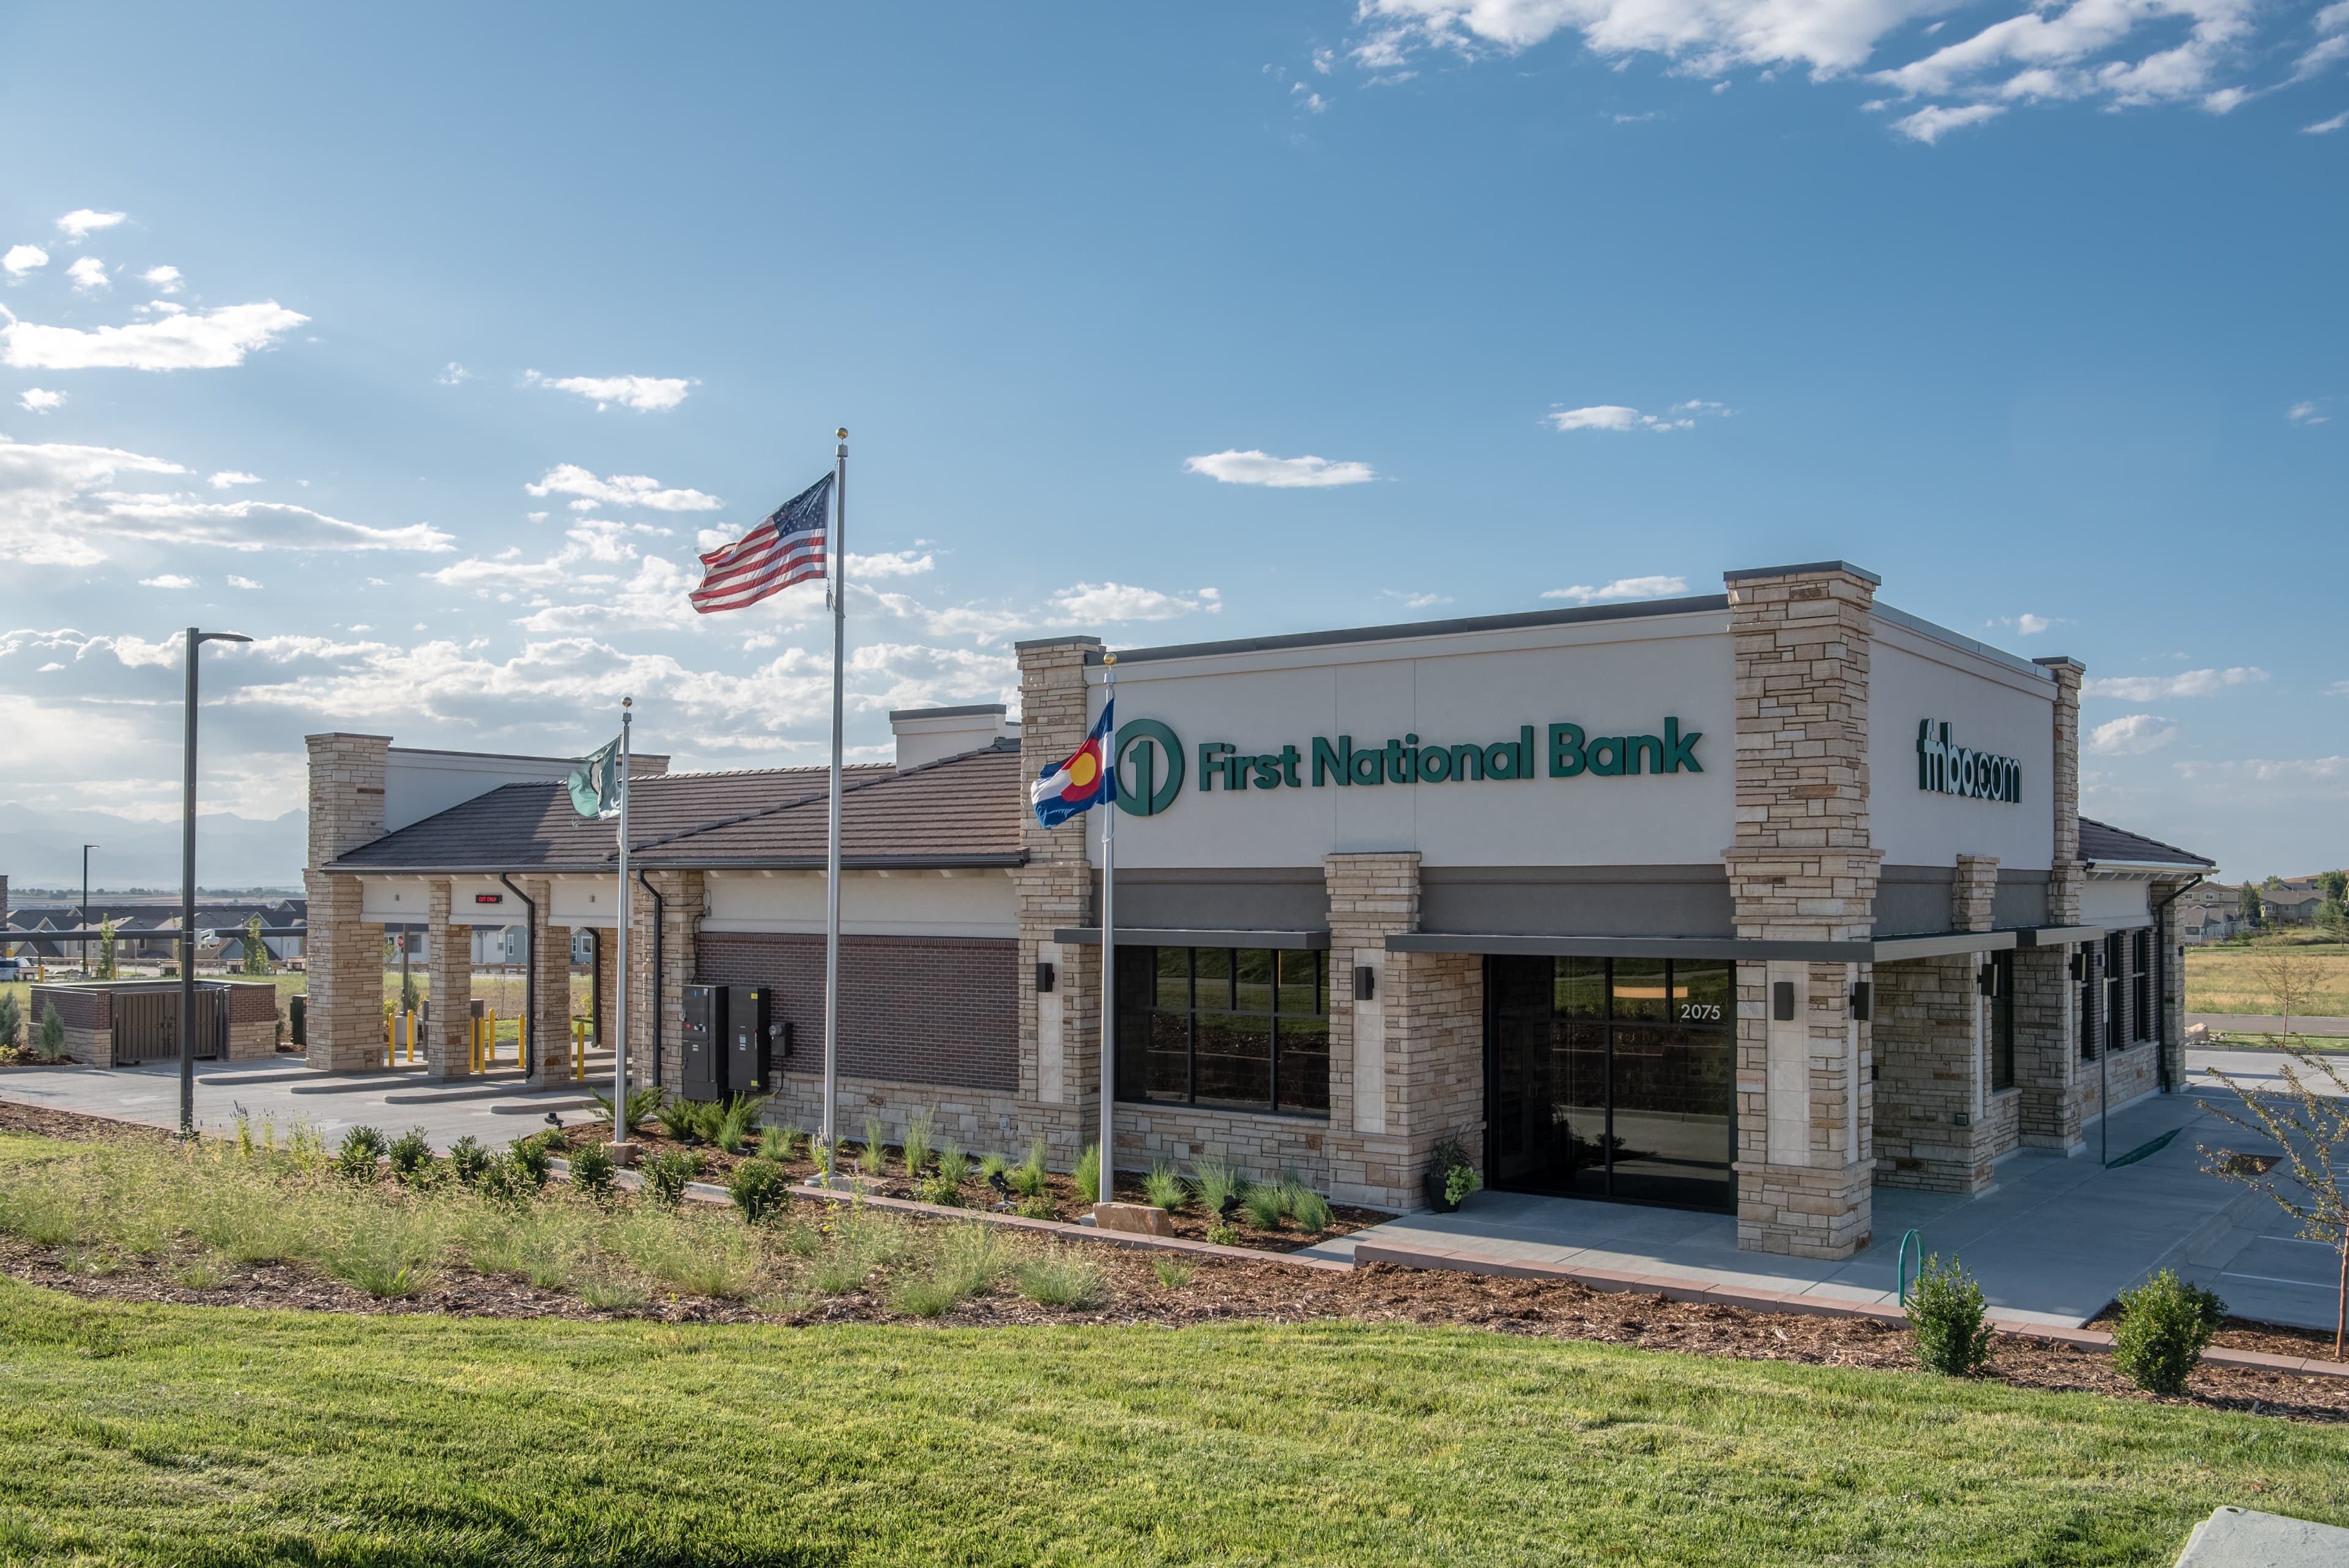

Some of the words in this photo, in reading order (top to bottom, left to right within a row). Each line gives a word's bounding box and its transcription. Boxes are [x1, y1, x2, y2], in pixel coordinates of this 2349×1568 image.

[1199, 742, 1301, 791] First
[1312, 725, 1534, 787] National
[1549, 716, 1704, 778] Bank
[1917, 718, 2022, 804] fnbo.com
[1681, 1004, 1721, 1020] 2075
